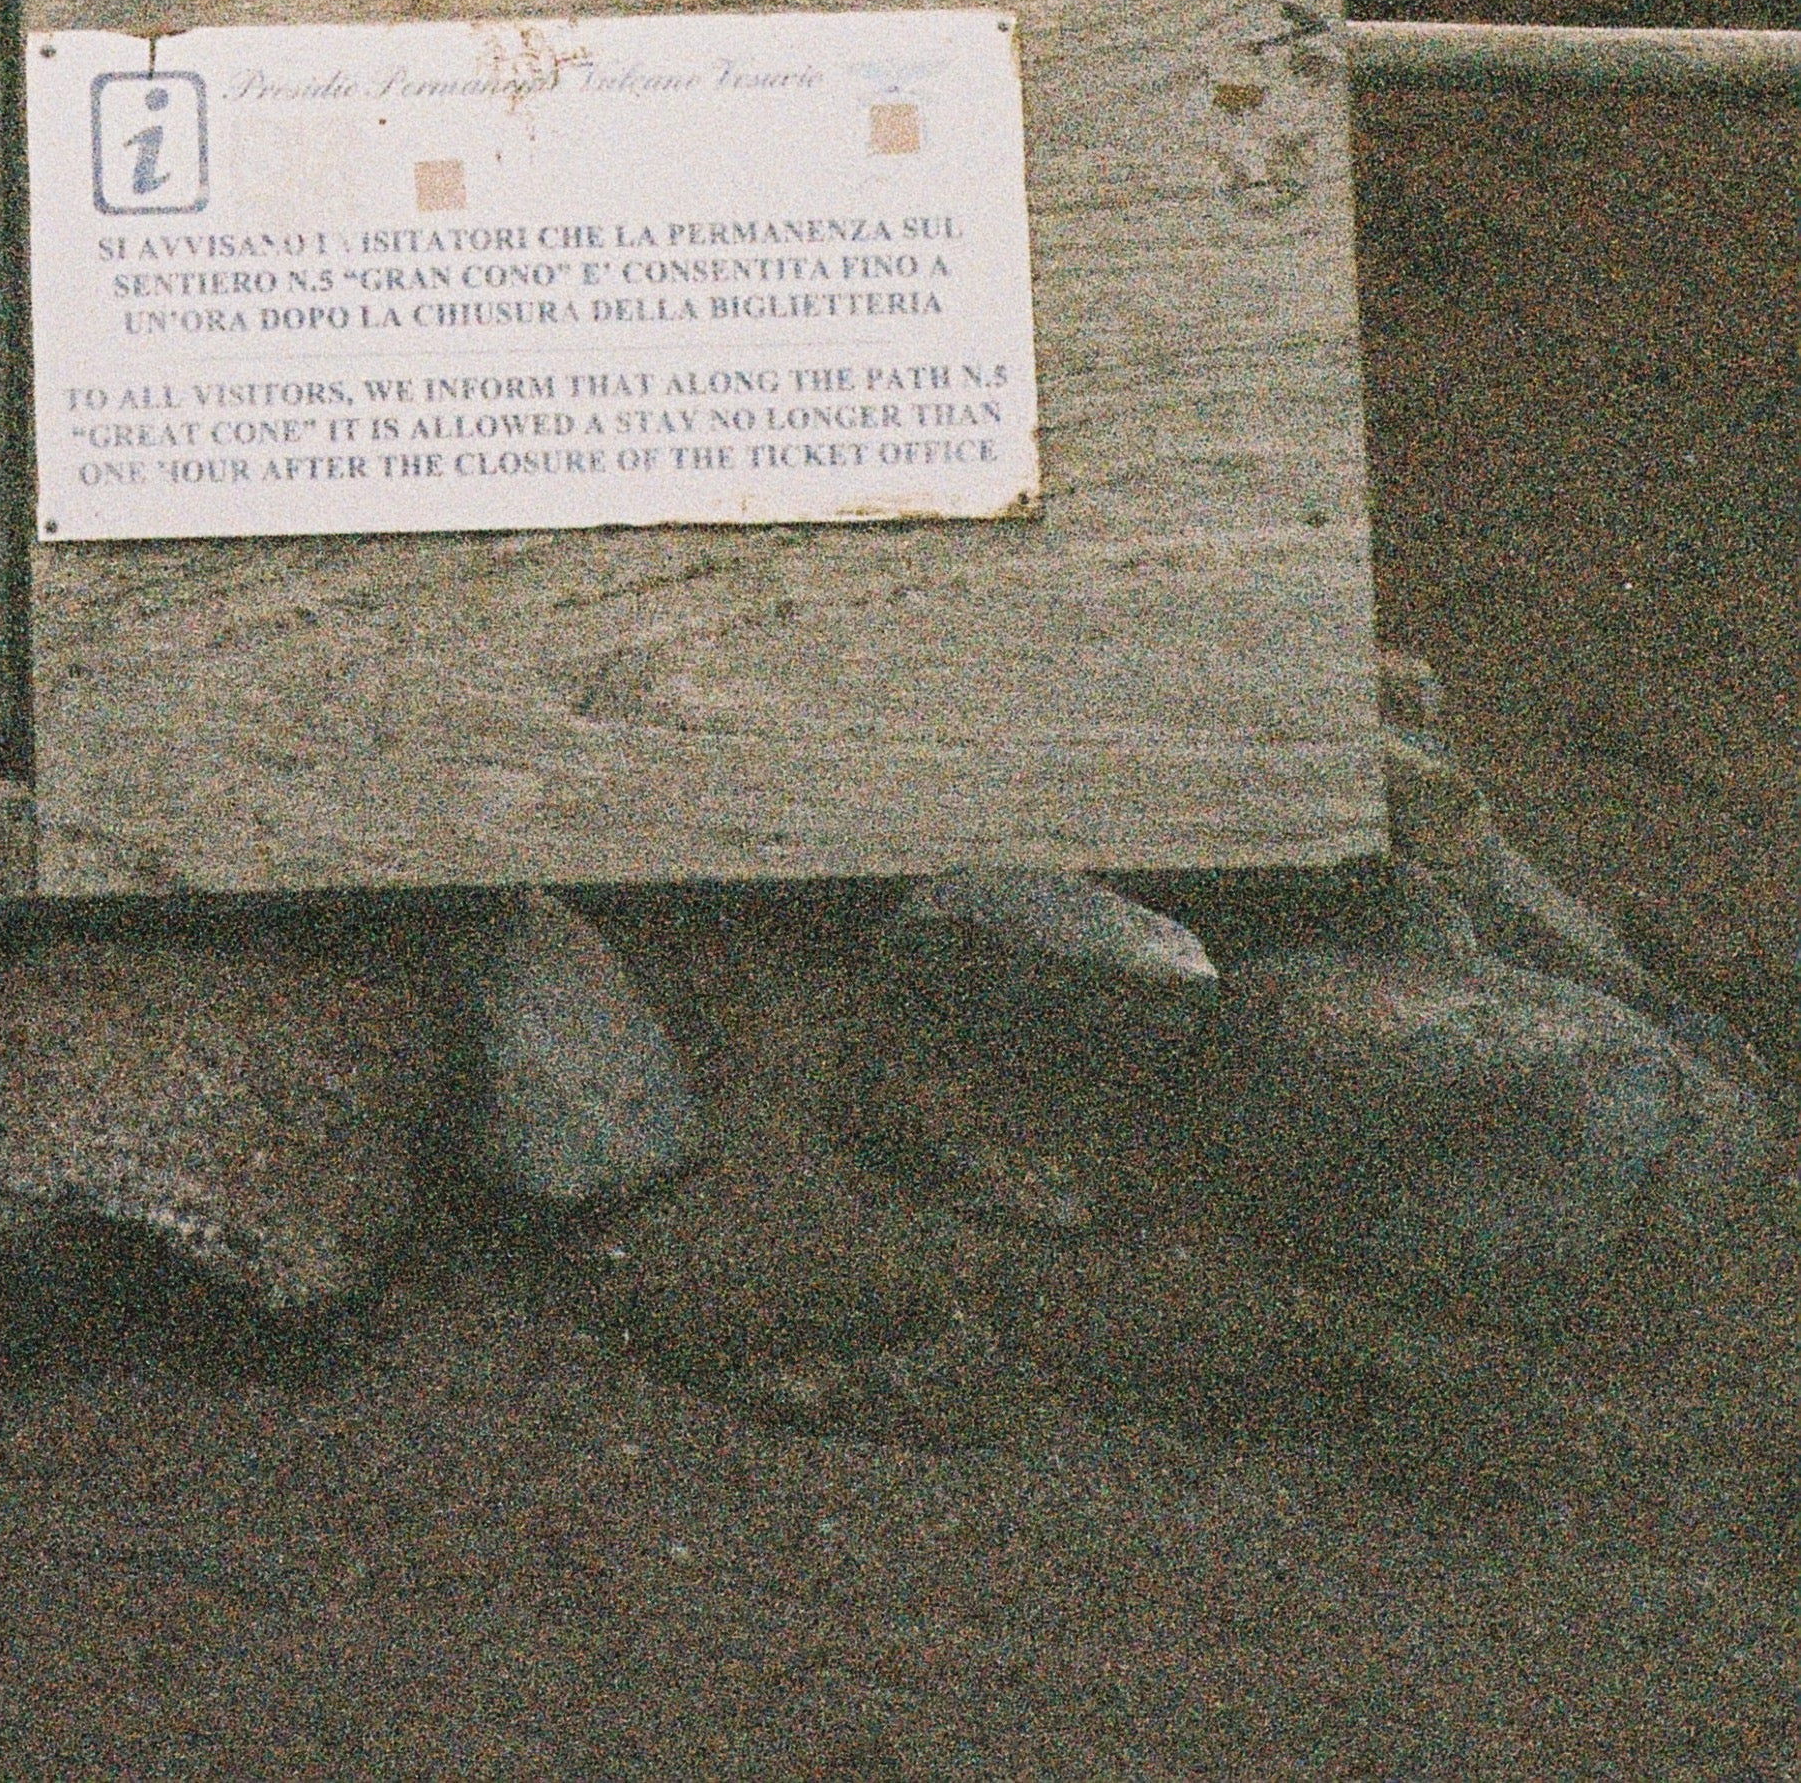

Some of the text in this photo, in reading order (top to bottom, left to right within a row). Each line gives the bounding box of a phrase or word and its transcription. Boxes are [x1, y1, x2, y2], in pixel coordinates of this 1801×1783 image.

[99, 237, 126, 261] SI
[316, 232, 327, 255] I
[338, 228, 527, 255] ISITATORI
[538, 226, 606, 251] CHE
[616, 223, 656, 248] LA
[669, 218, 892, 248] PERMANENZA
[903, 216, 964, 240] SUL
[113, 271, 278, 298] SENTIERO
[288, 271, 334, 293] N.5
[622, 255, 830, 284] CONSENTITA
[842, 255, 918, 279] FINO
[930, 254, 951, 277] A
[124, 291, 943, 336] UN'ORA DOPO LA CHIUSURA DELLA BIGLIETTERIA
[63, 363, 1009, 412] TO ALL VISITORS, WE INFORM THAT ALONG THE PATH N.5
[327, 418, 361, 443] IT
[371, 417, 399, 442] IS
[411, 412, 575, 440] ALLOWED
[584, 412, 604, 436] A
[616, 409, 705, 436] STAY
[710, 407, 757, 432] NO
[767, 404, 903, 430] LONGER
[913, 400, 1002, 428] THAN
[79, 439, 999, 487] ONE HOUR AFTER THE CLOSURE OF THE TICKET OFFICE
